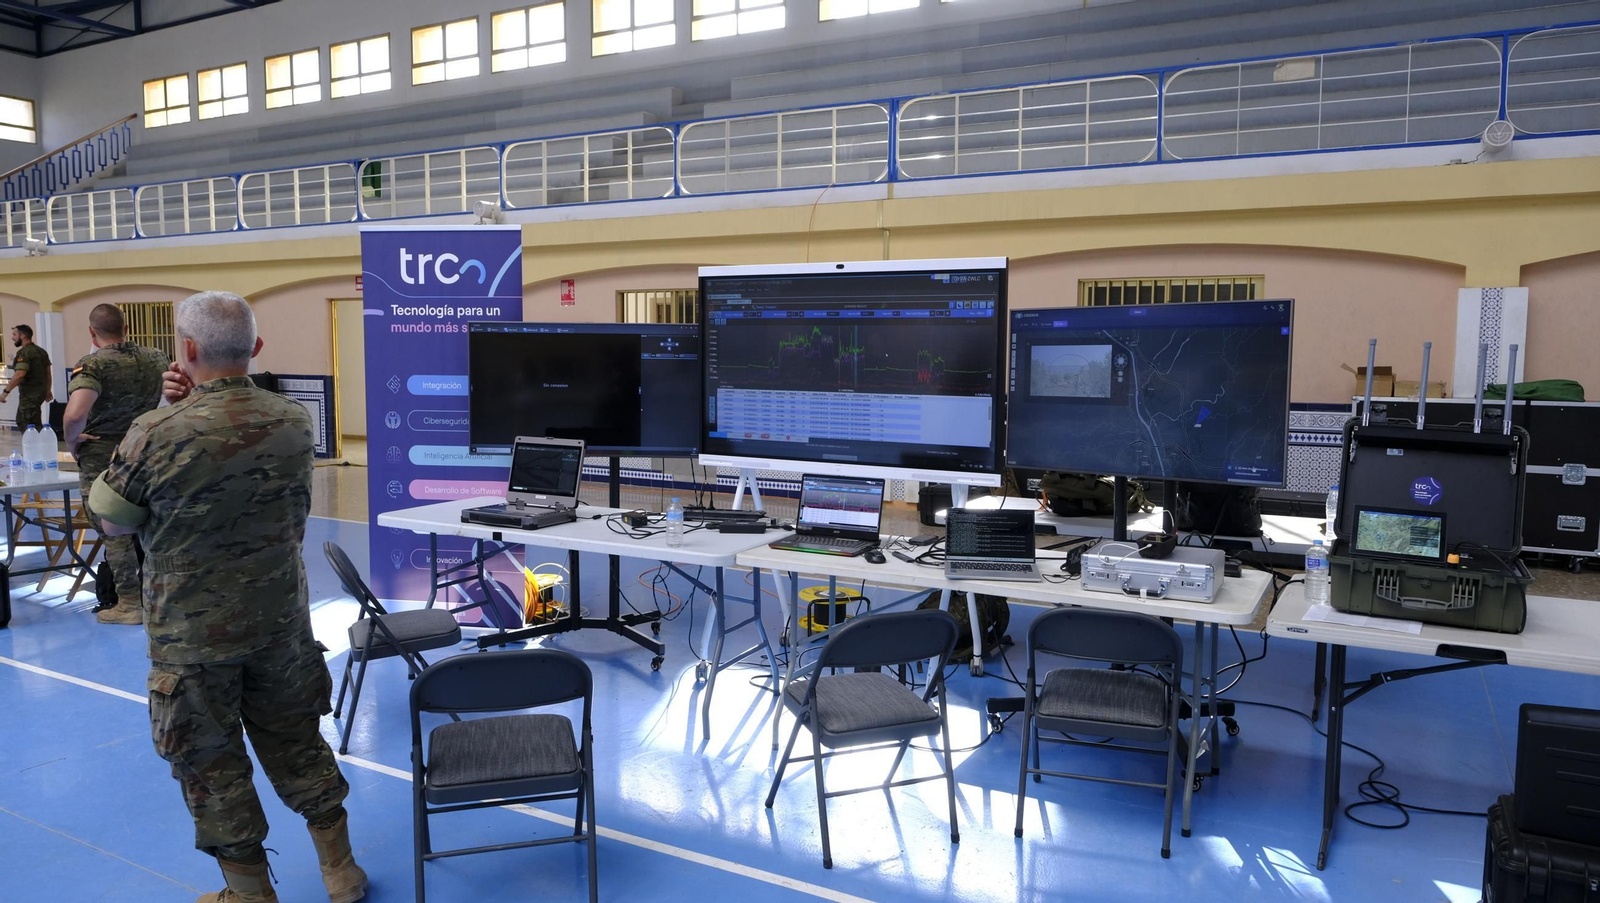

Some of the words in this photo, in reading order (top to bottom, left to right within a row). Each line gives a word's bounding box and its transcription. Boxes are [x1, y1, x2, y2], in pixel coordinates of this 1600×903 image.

[390, 304, 454, 319] Tecnología
[457, 307, 483, 319] para
[486, 307, 501, 316] un
[390, 321, 432, 333] mundo
[434, 321, 459, 333] más
[461, 324, 468, 333] s
[422, 381, 462, 391] Integración
[424, 452, 464, 461] Inteligencia
[424, 486, 459, 494] Desarrollo
[470, 487, 502, 495] Software
